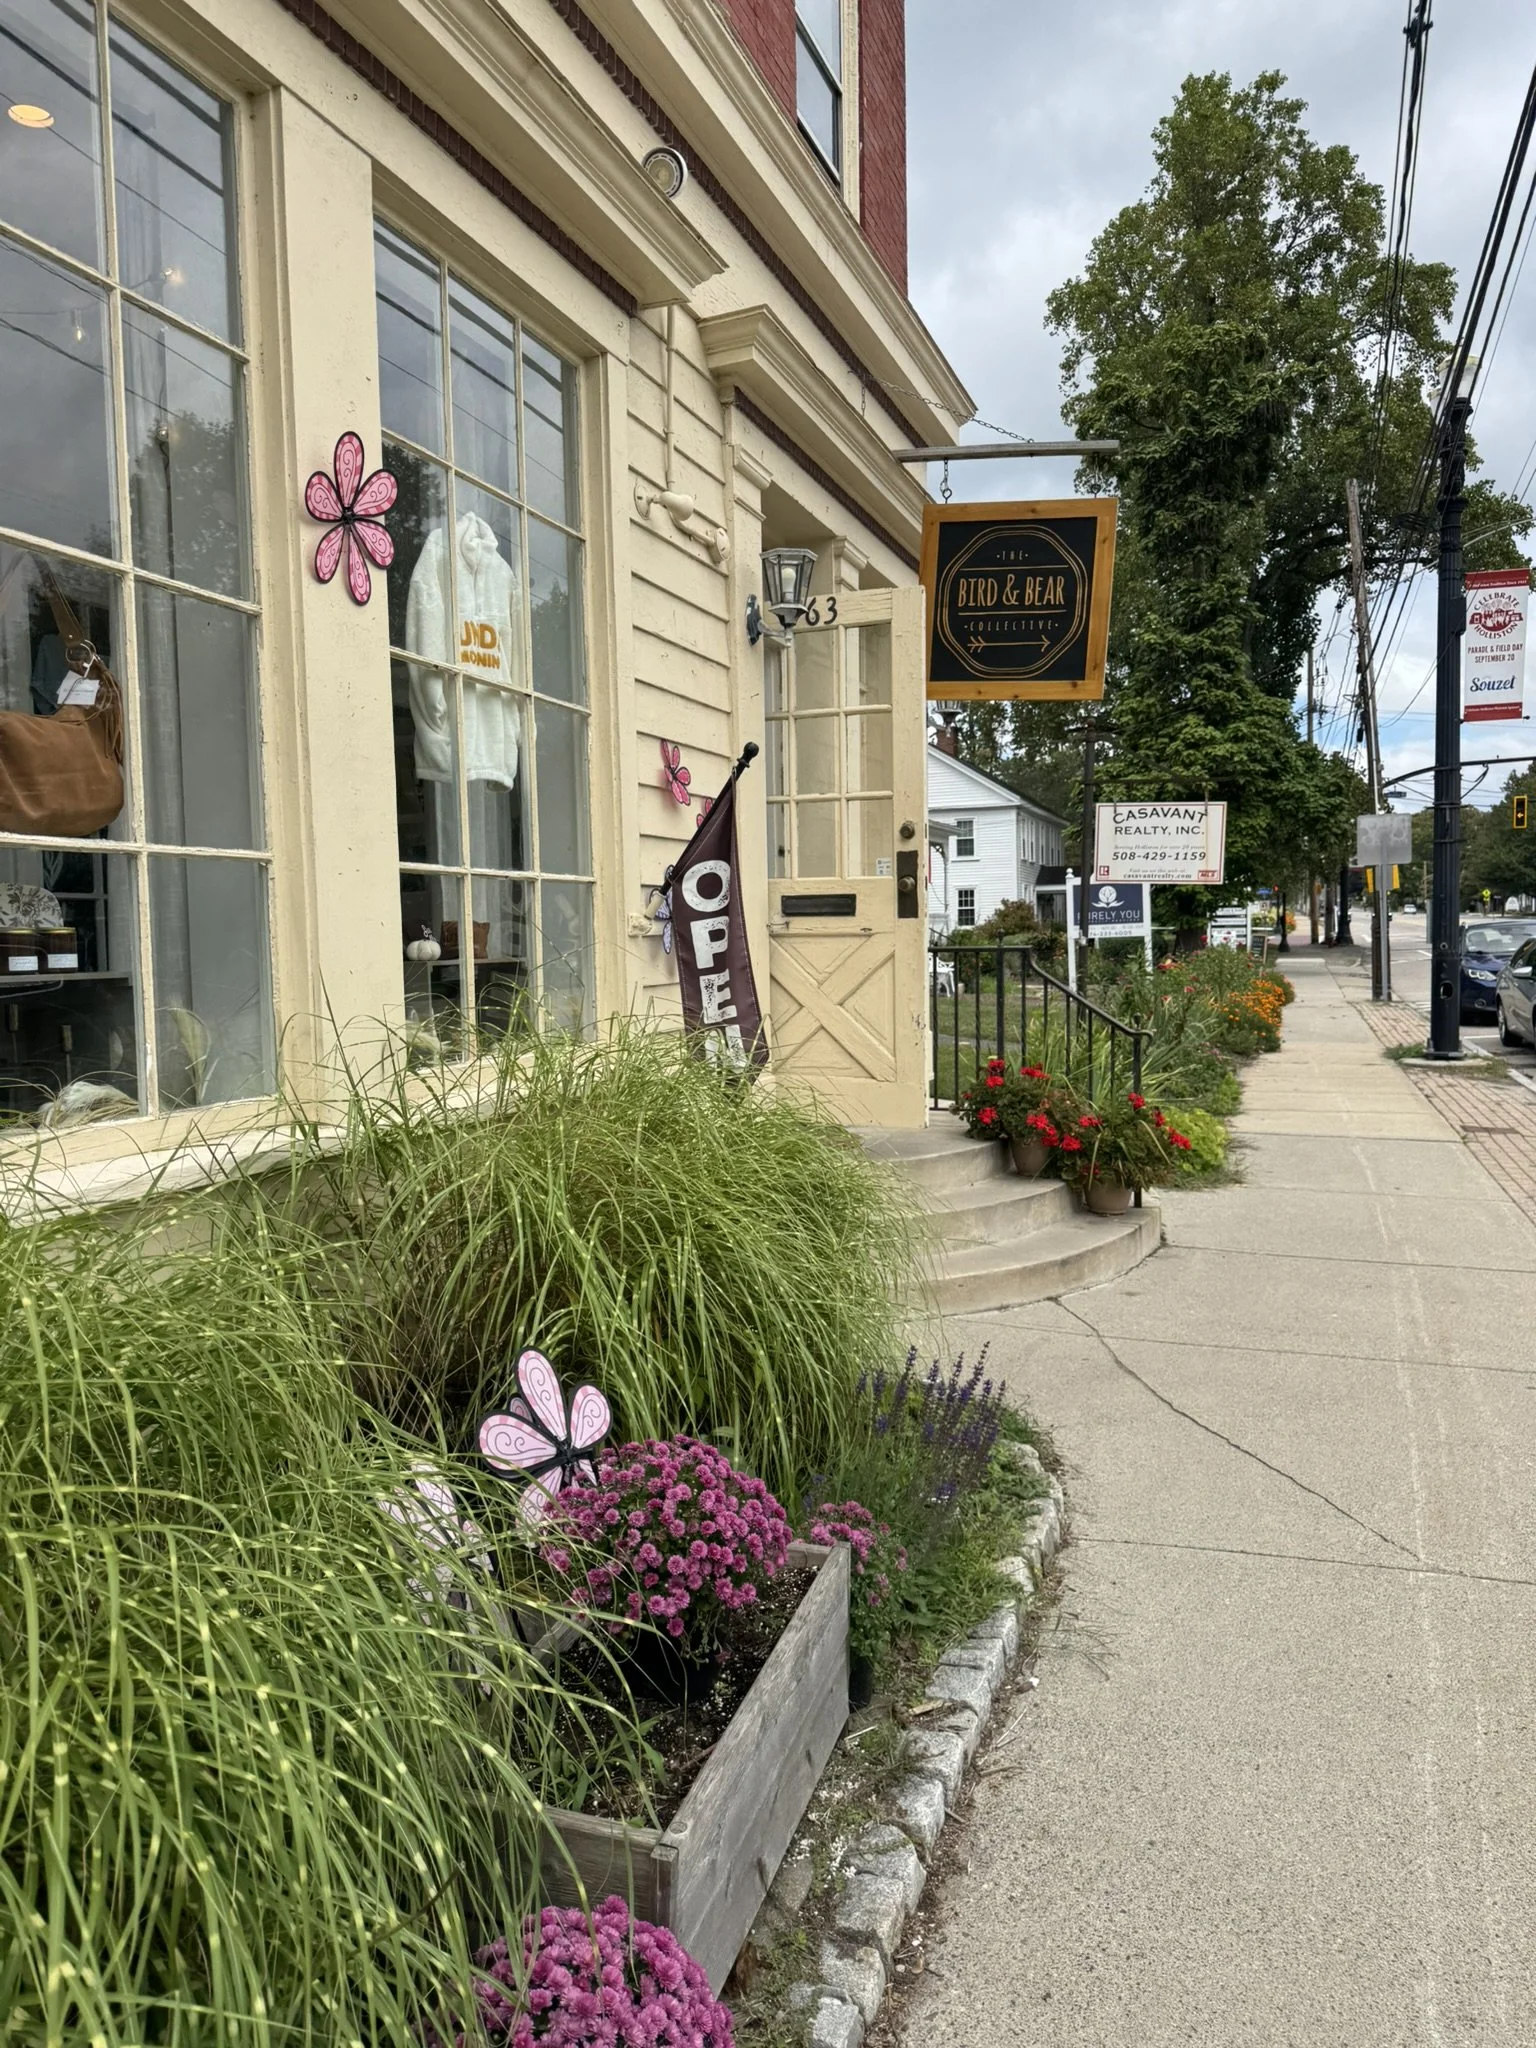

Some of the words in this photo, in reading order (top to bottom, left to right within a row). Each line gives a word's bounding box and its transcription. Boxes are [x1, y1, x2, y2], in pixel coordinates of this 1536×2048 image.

[1002, 550, 1023, 560] THE
[957, 577, 998, 607] BIRD
[1002, 573, 1020, 605] &
[1024, 576, 1065, 606] BEAR
[1474, 592, 1519, 610] CELEBRATE
[969, 620, 1052, 631] COLLECTIVE
[1474, 622, 1518, 639] HOLLISTON
[1468, 646, 1488, 654] PARADE
[1496, 644, 1511, 652] FIELD
[1475, 655, 1506, 663] SEPTEMBER
[1113, 807, 1208, 824] CASAVANT
[1114, 826, 1172, 836] REALTY,
[1176, 826, 1205, 835] INC.
[1112, 851, 1206, 861] 508-429-1159
[1120, 910, 1140, 918] YOU
